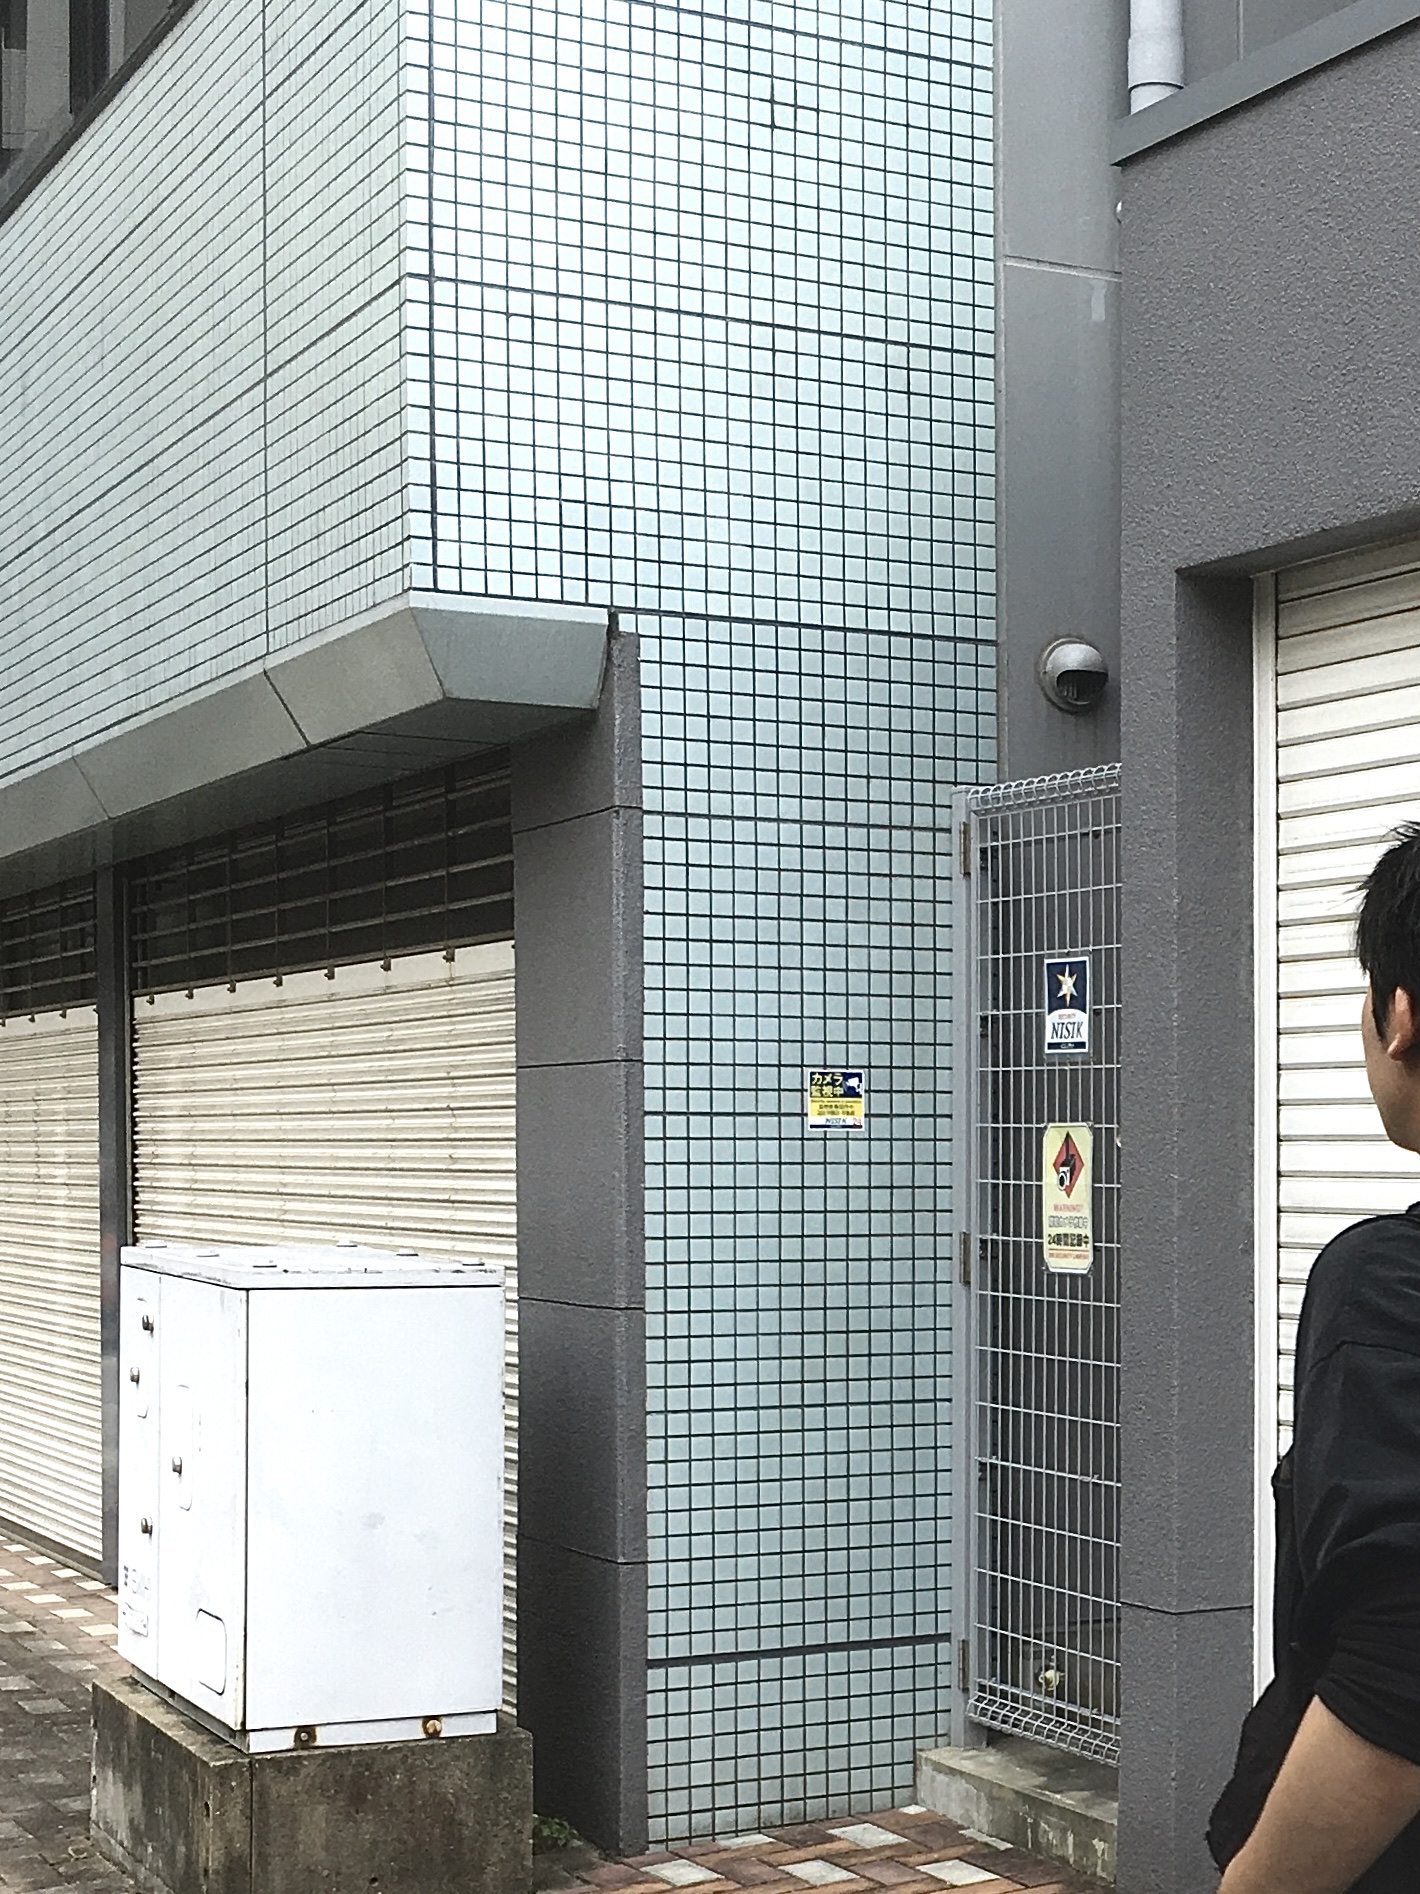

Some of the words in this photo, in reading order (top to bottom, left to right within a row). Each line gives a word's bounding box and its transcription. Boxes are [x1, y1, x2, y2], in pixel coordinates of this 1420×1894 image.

[1051, 1021, 1083, 1039] NISIK
[811, 1073, 843, 1085] カメラ
[811, 1085, 844, 1097] 監視中
